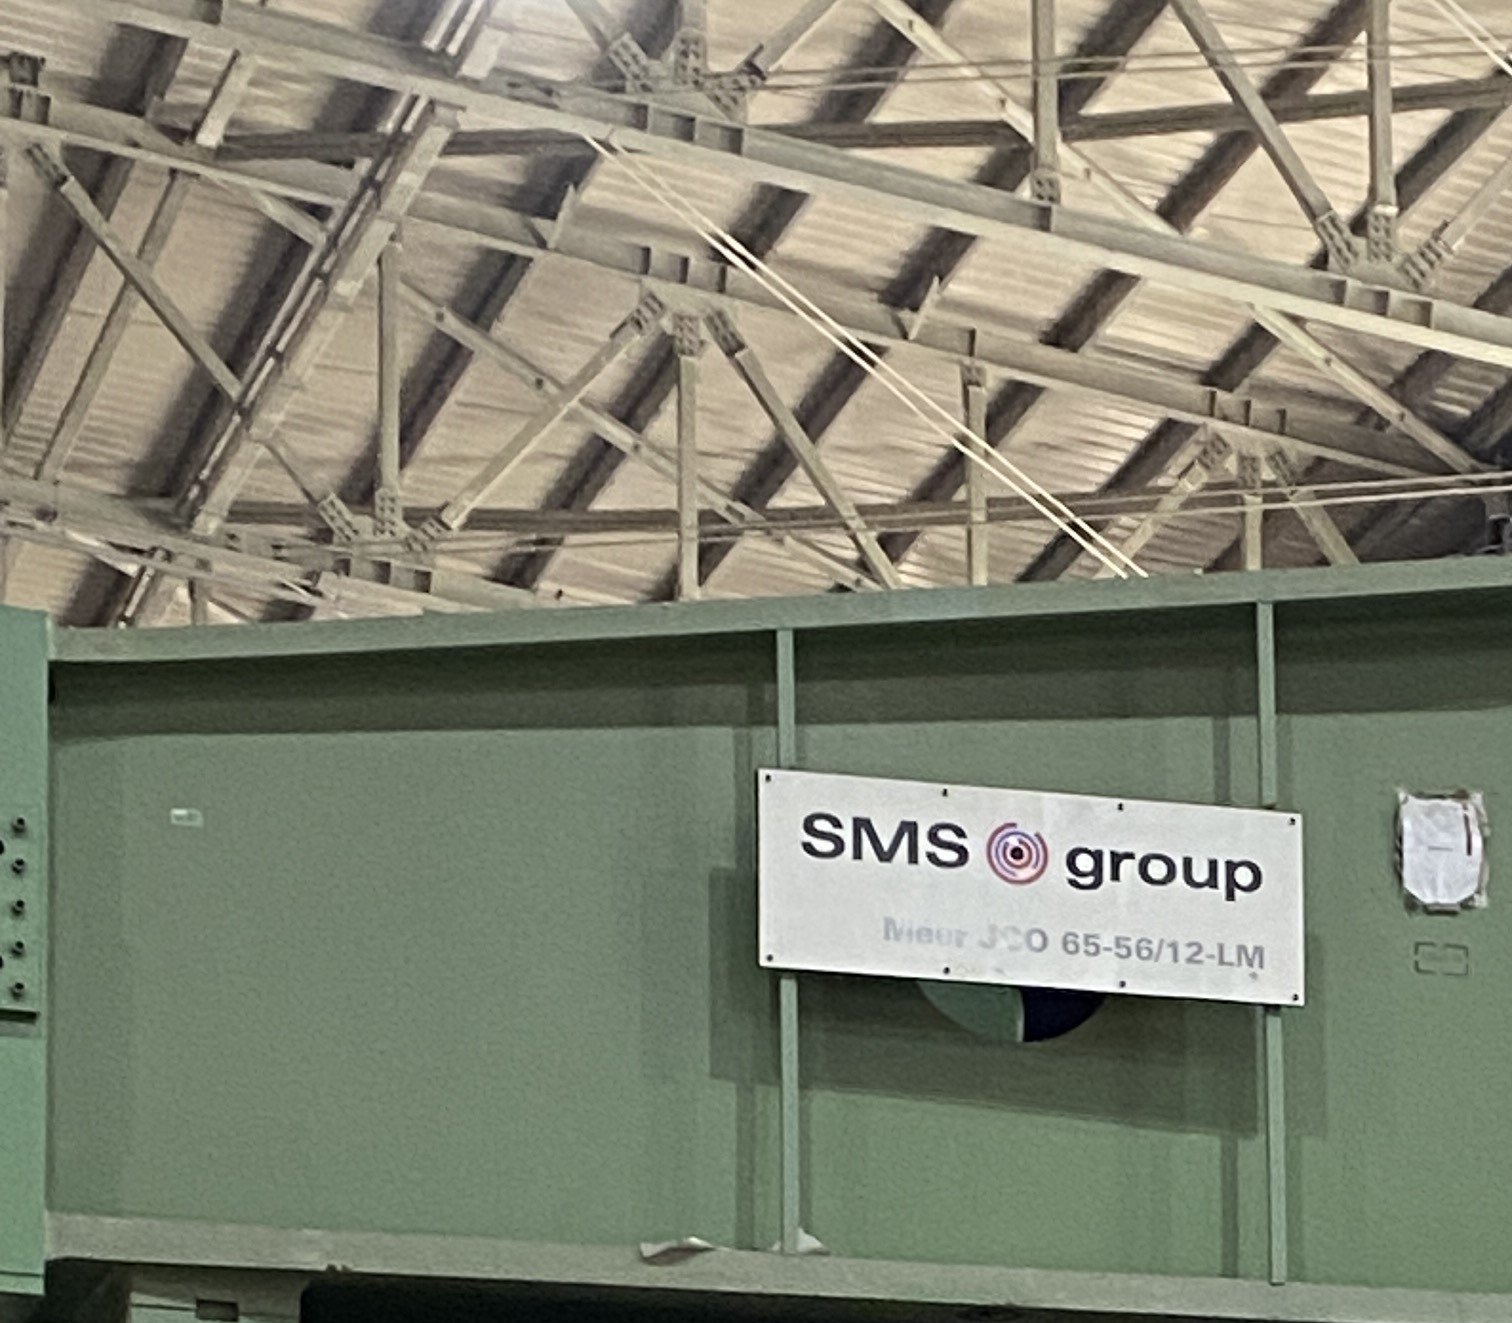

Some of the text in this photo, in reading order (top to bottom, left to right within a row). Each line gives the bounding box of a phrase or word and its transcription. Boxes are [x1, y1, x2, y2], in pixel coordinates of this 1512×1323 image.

[800, 811, 1264, 902] SMS group
[1061, 930, 1266, 970] 65-56/12-LM
